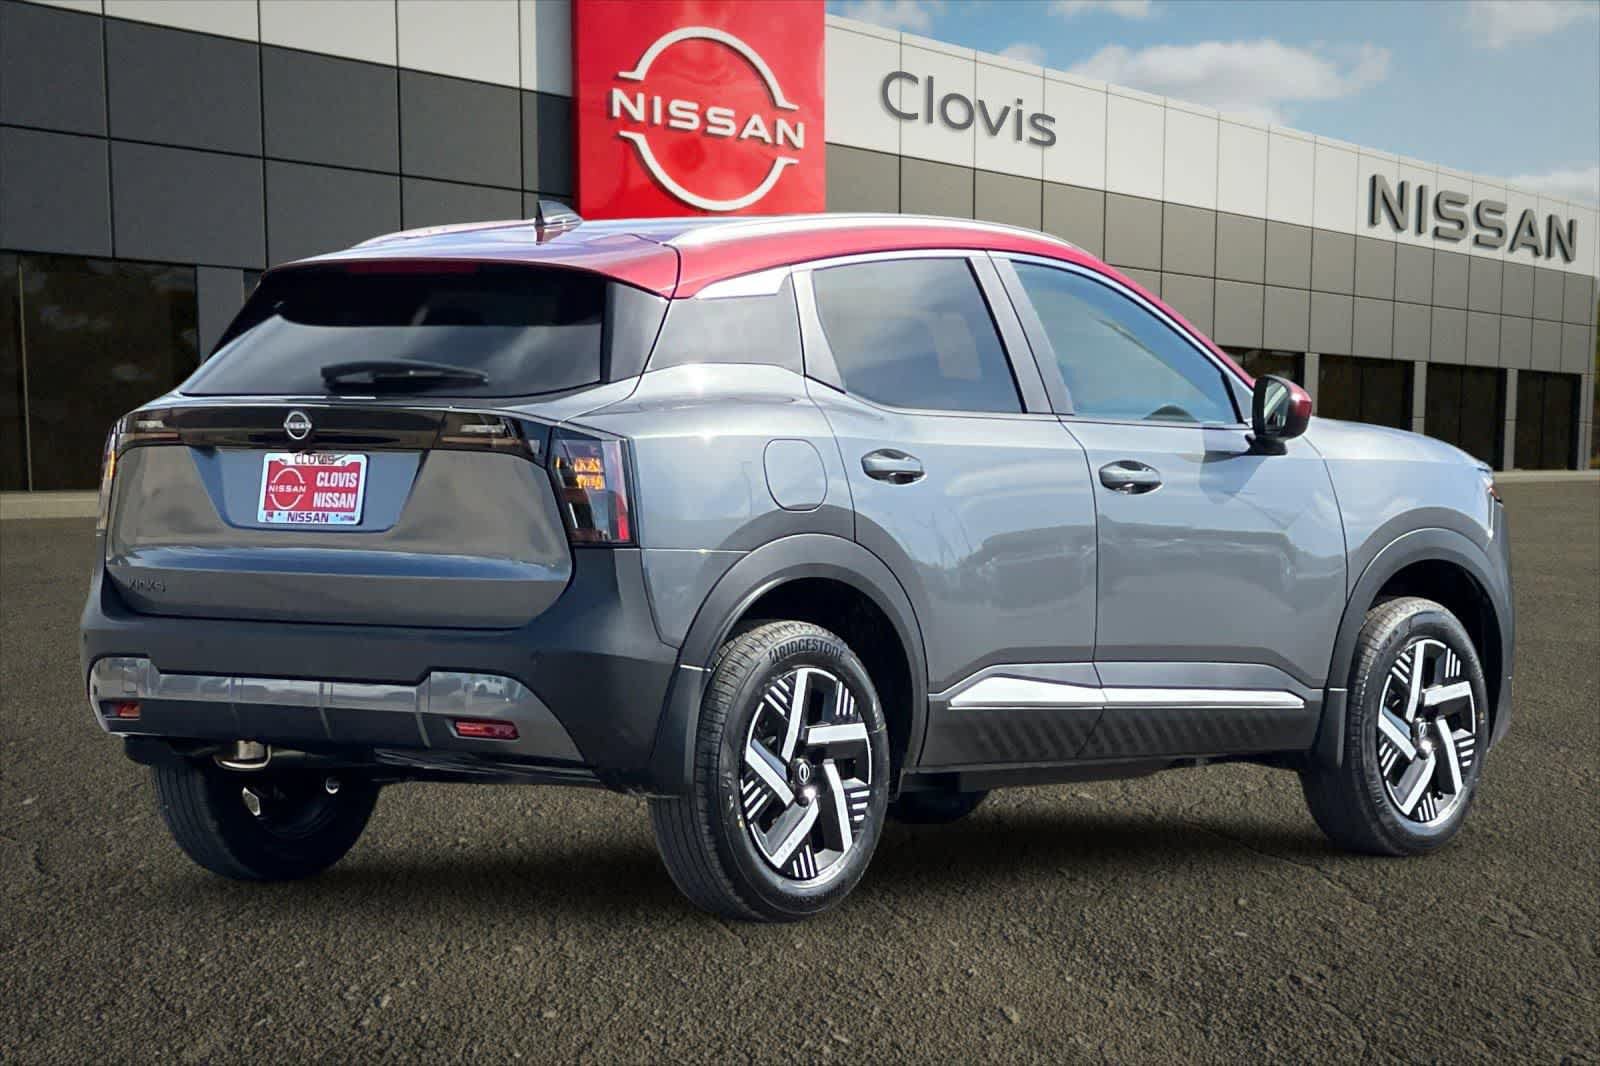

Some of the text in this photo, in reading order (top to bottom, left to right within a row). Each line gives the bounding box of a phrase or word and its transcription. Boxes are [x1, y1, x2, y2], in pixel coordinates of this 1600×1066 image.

[881, 71, 1057, 148] Clovis
[611, 88, 805, 149] NISSAN
[1368, 173, 1578, 264] NISSAN
[294, 453, 335, 465] CLOVIS
[316, 471, 358, 488] CLOVIS
[268, 484, 307, 493] NISSAN
[313, 492, 356, 509] NISSAN
[287, 511, 329, 523] NISSAN
